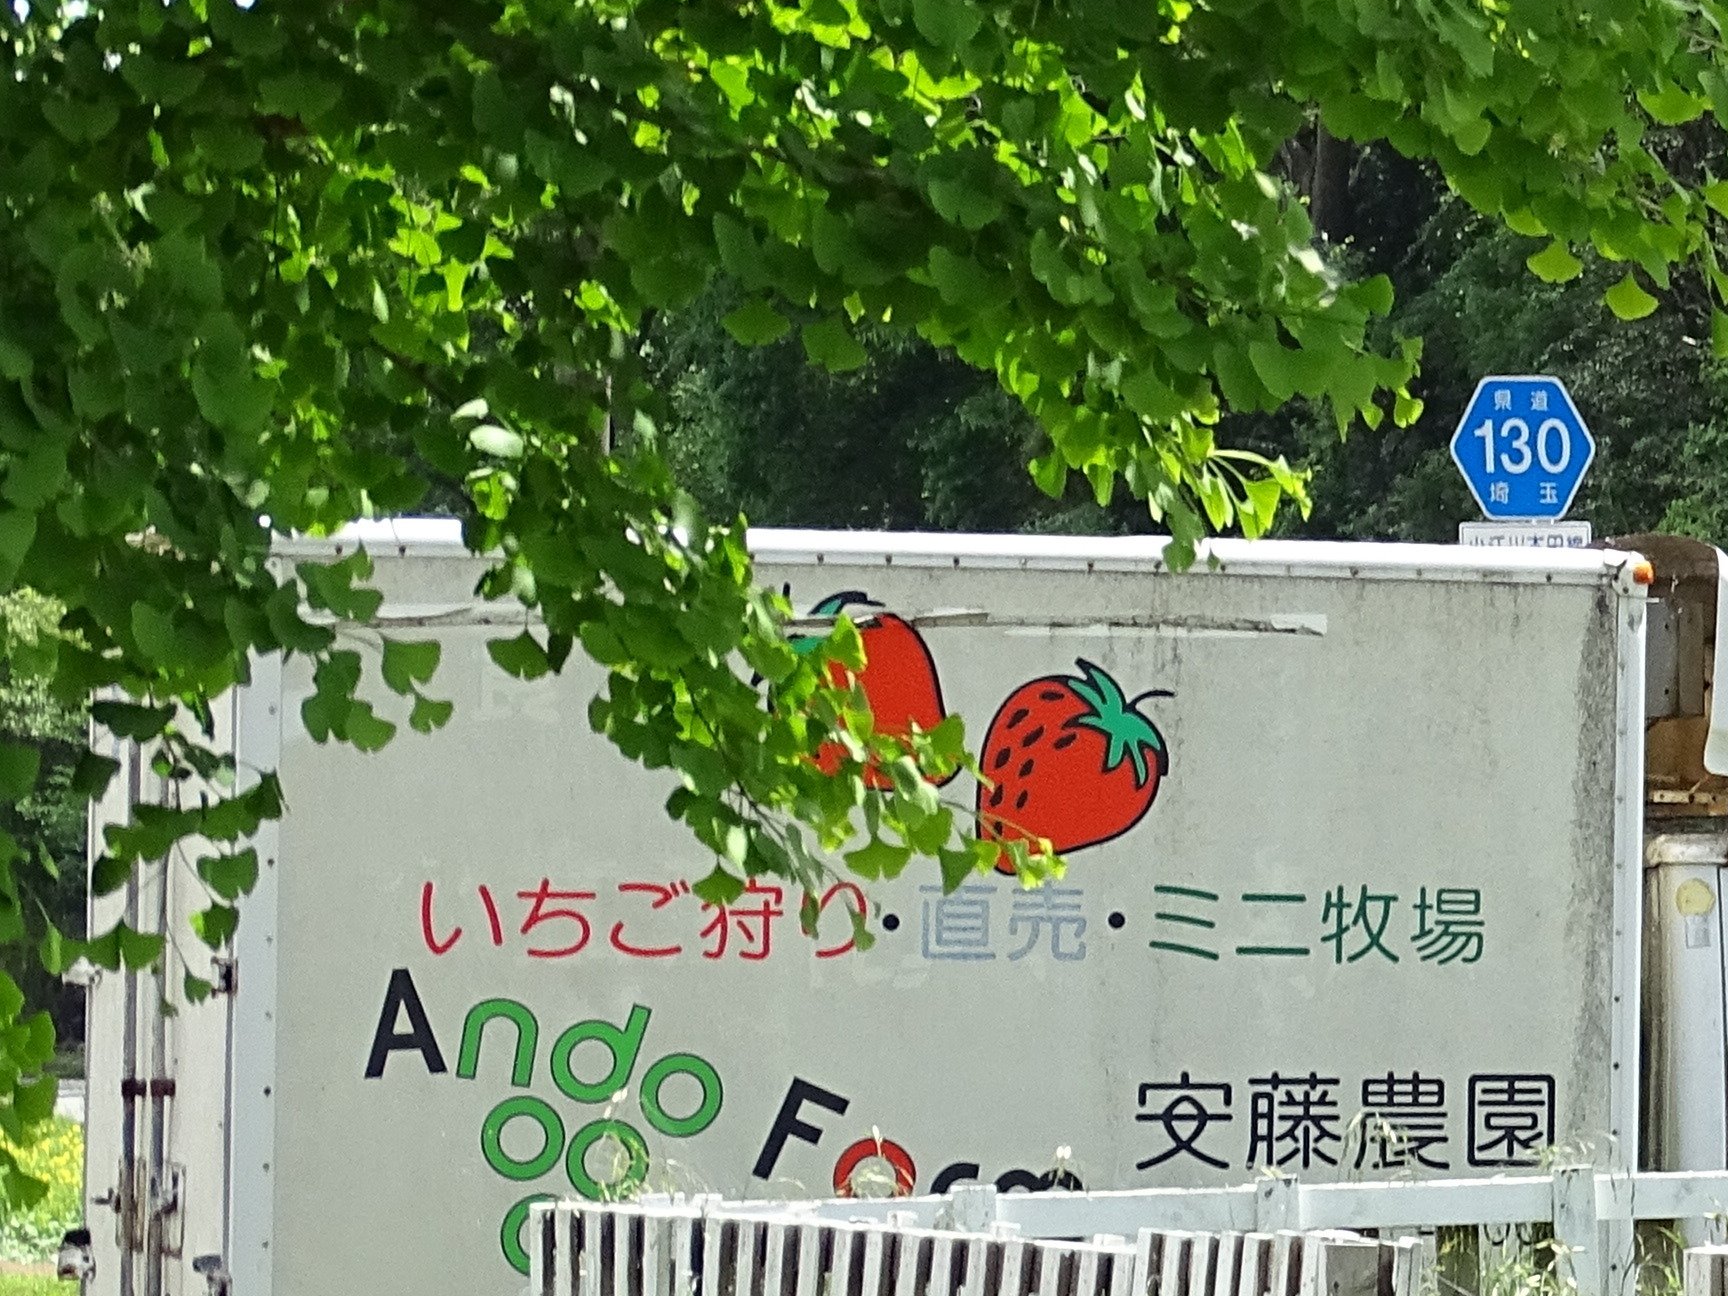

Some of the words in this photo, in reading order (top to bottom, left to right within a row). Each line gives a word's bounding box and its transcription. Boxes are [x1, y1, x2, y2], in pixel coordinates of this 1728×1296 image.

[1493, 388, 1549, 412] 県道
[1473, 416, 1571, 475] 130
[1489, 481, 1559, 505] 埼玉
[364, 968, 724, 1138] Ando
[1135, 1071, 1556, 1171] 安藤農園
